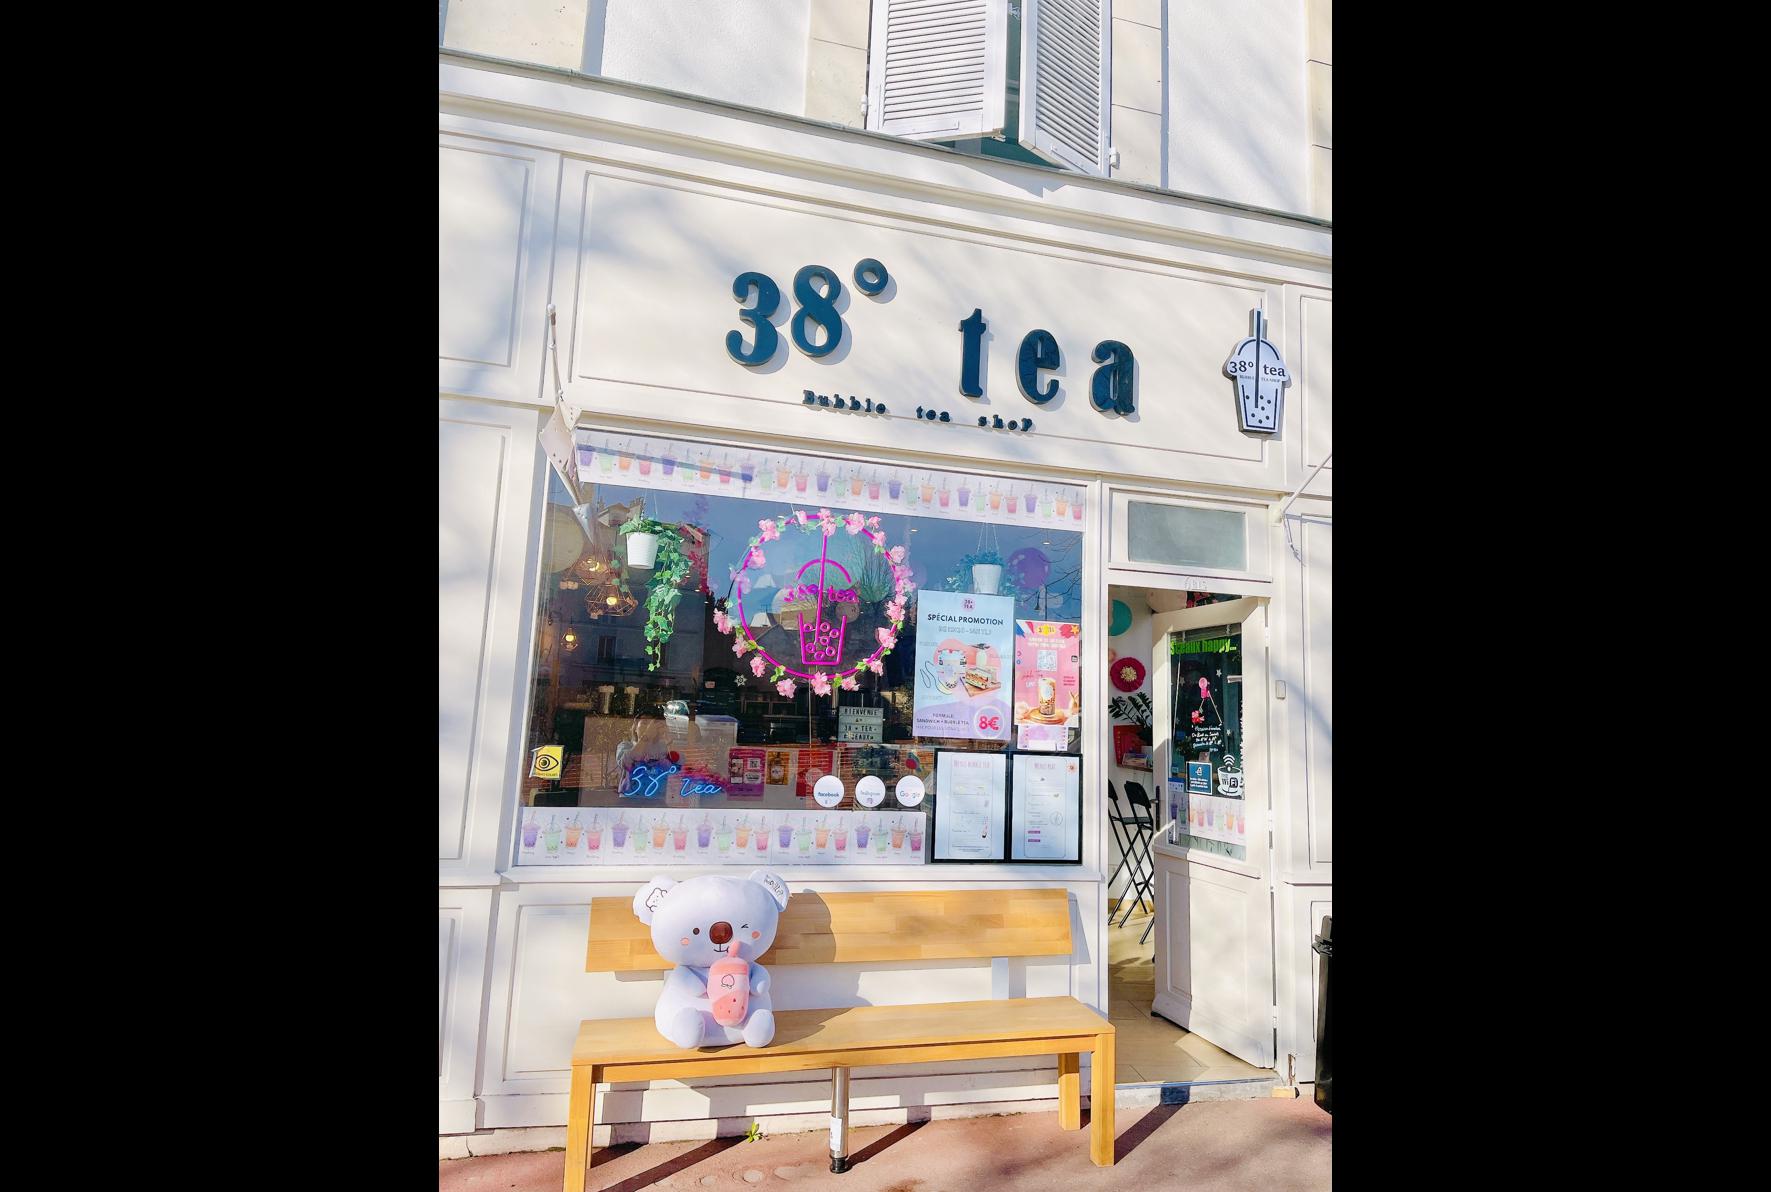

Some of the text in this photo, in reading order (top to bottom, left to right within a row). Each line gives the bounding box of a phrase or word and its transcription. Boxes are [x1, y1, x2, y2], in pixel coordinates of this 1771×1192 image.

[726, 257, 1137, 416] 38° tea
[1229, 360, 1286, 377] 38° tea
[802, 389, 1034, 432] Bubble tea shop
[827, 584, 859, 604] tea
[927, 612, 1004, 625] SPÉCIAL PROMOTION
[844, 708, 877, 716] BIENVENUE
[978, 715, 1000, 730] 8€
[680, 778, 722, 797] tea
